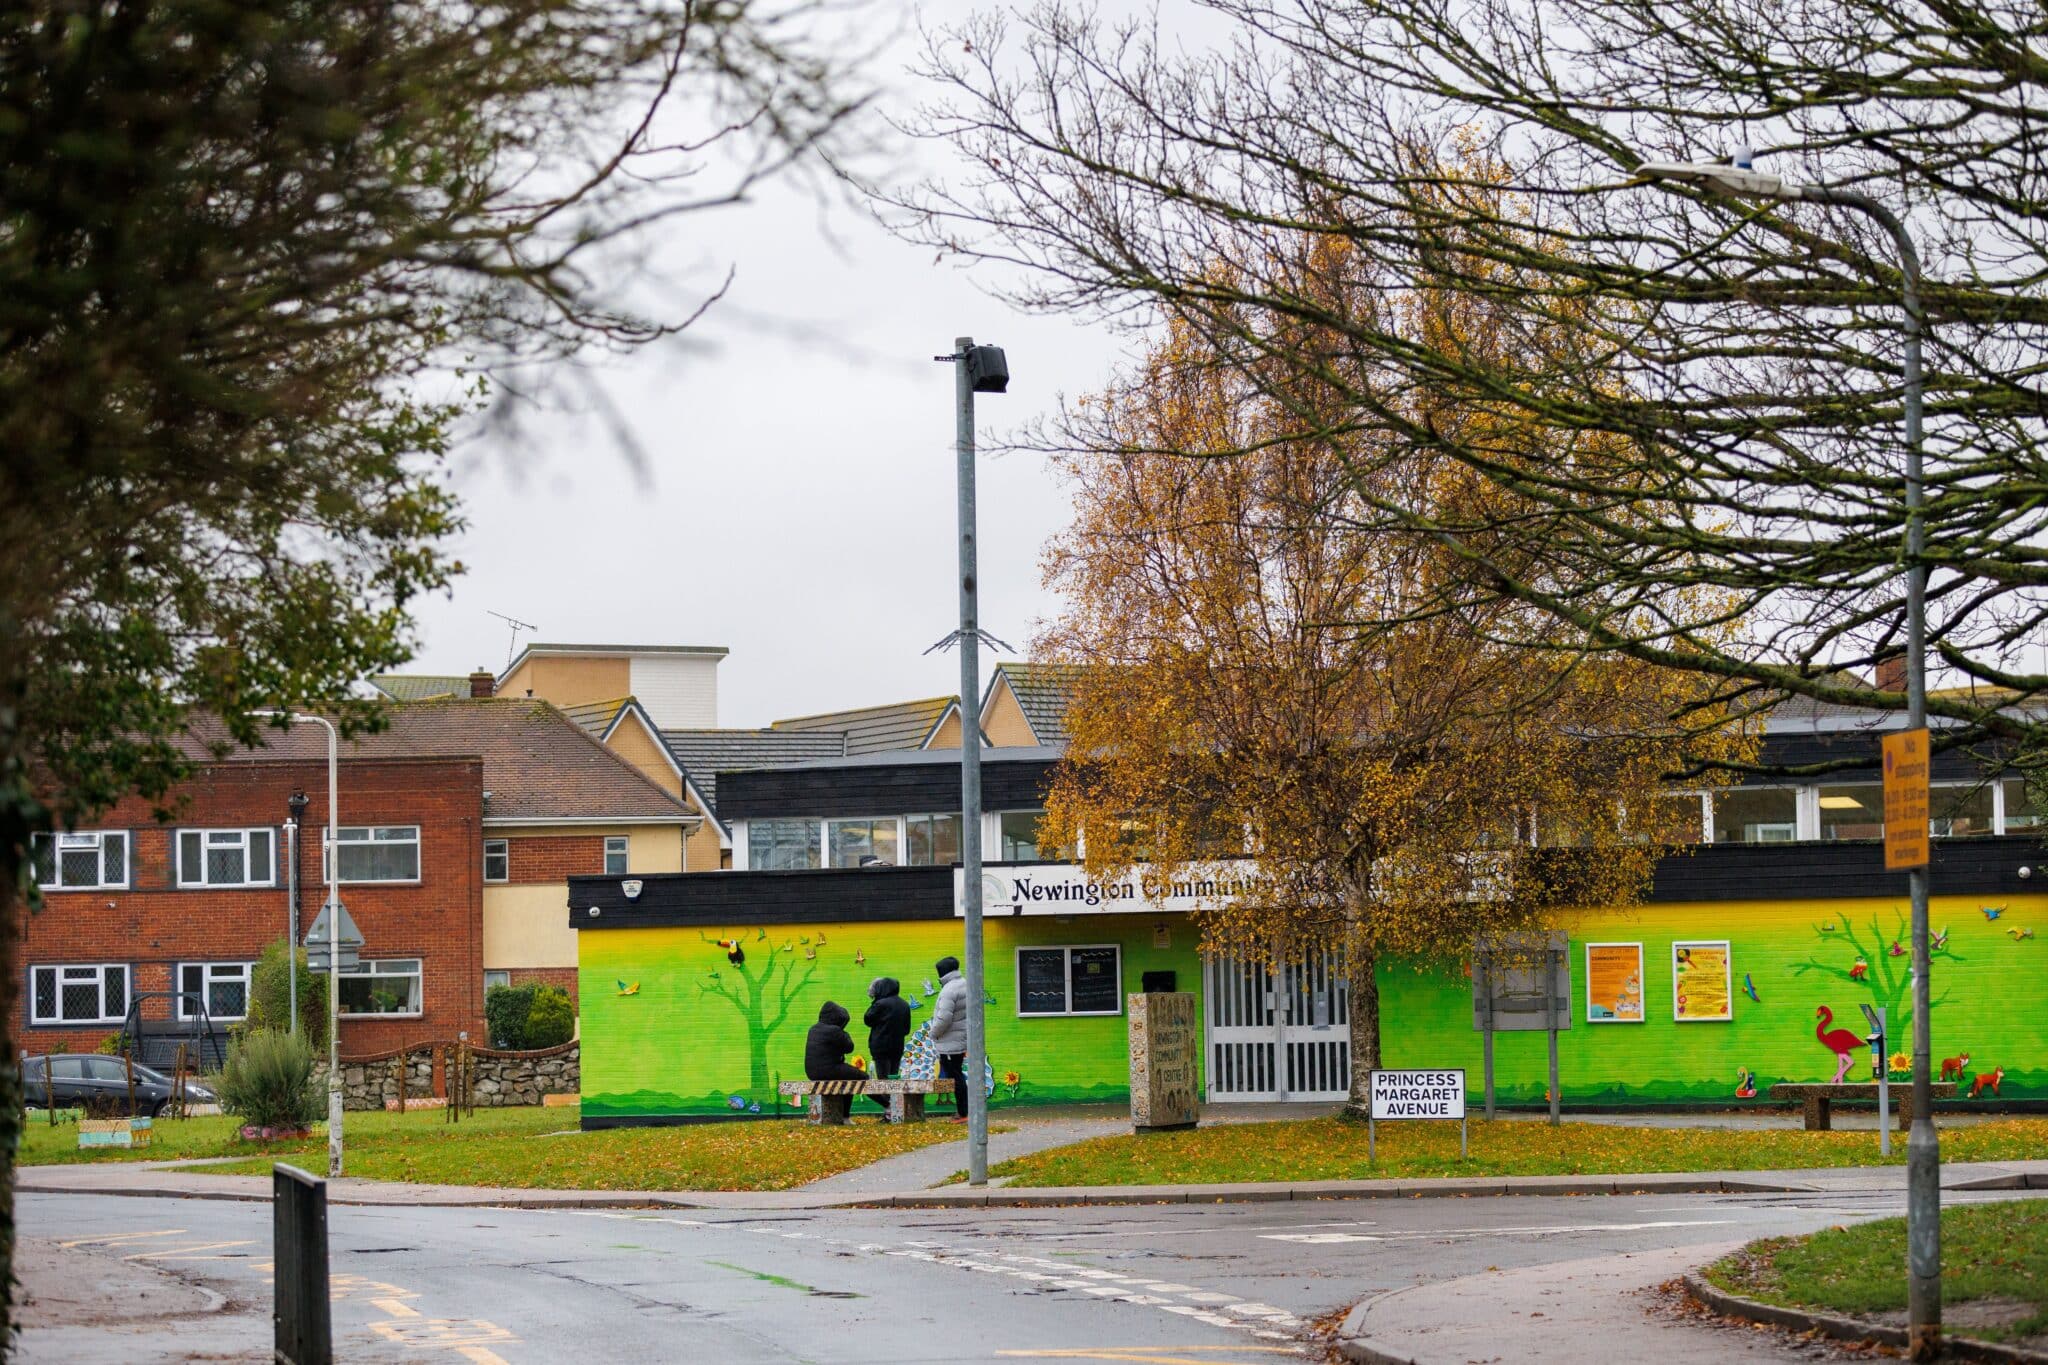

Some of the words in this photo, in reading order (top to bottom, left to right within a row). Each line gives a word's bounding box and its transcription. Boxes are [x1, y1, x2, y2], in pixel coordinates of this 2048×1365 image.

[1378, 1074, 1457, 1087] PRINCESS
[1375, 1088, 1460, 1101] MARGARET
[1387, 1103, 1449, 1115] AVENUE
